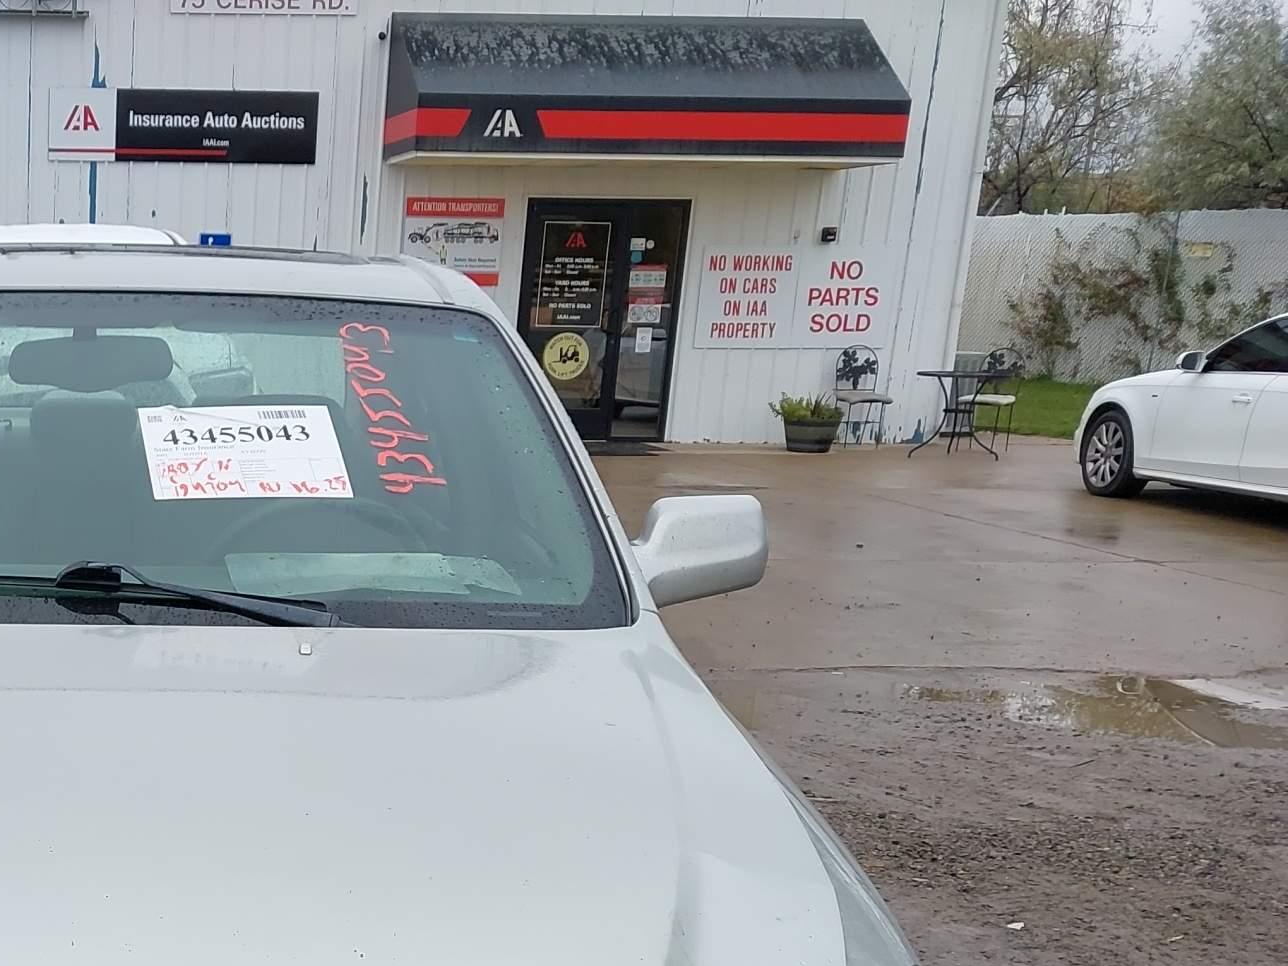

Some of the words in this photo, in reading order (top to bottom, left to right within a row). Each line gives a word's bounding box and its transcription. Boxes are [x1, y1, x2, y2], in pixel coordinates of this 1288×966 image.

[129, 110, 200, 128] Insurance
[203, 111, 238, 129] Auto
[241, 112, 305, 130] Auctions
[412, 202, 447, 212] ATTENTION
[709, 255, 727, 272] NO
[733, 255, 793, 272] WORKING
[830, 261, 864, 280] NO
[719, 278, 737, 294] ON
[743, 278, 777, 294] CARS
[808, 287, 879, 307] PARTS
[723, 300, 741, 317] ON
[746, 301, 768, 317] IAA
[710, 322, 776, 339] PROPERTY
[809, 314, 871, 333] SOLD
[163, 425, 310, 446] 43455043
